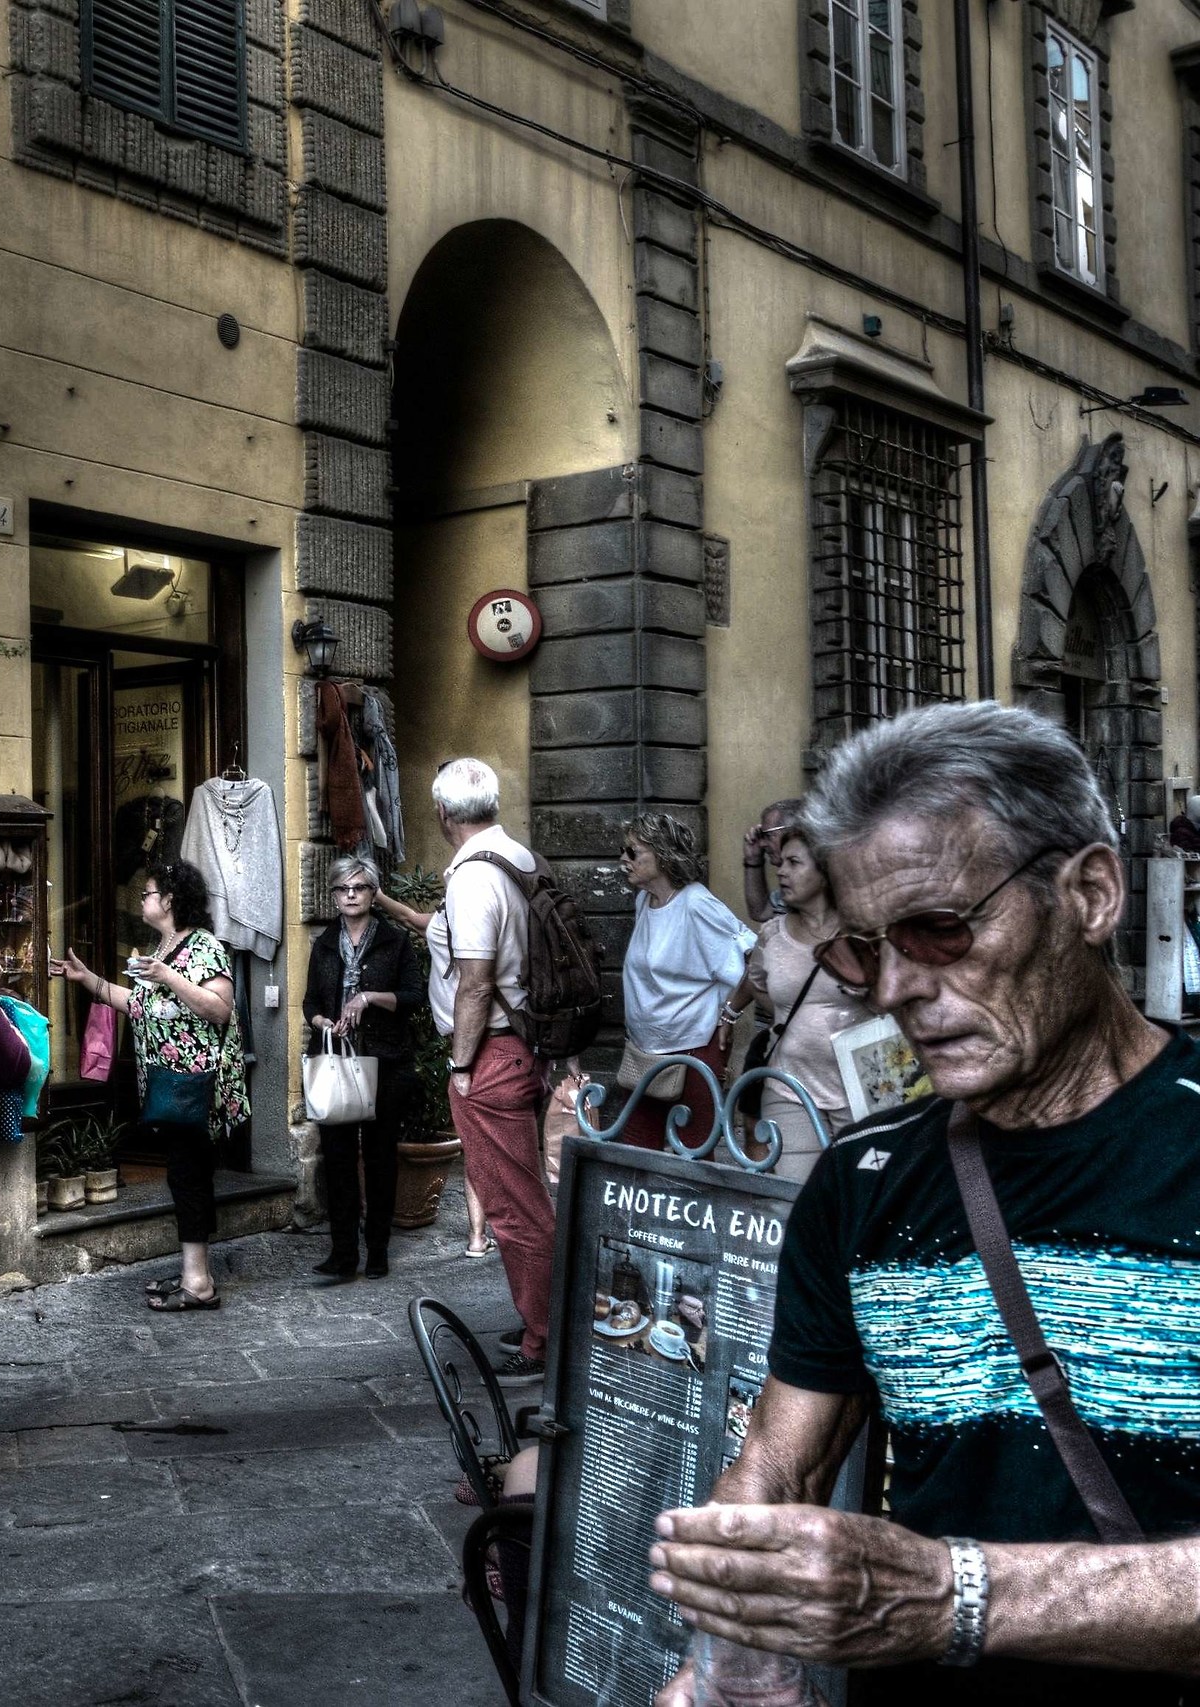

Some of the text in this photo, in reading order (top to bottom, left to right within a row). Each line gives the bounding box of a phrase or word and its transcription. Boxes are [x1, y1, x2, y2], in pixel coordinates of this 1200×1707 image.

[603, 1181, 717, 1234] ENOTECA
[628, 1228, 685, 1250] COFFEE BREAK
[723, 1252, 750, 1268] BIRRE
[657, 1414, 676, 1426] WINE
[676, 1421, 700, 1435] GLASS
[608, 1601, 643, 1624] BEVANDE
